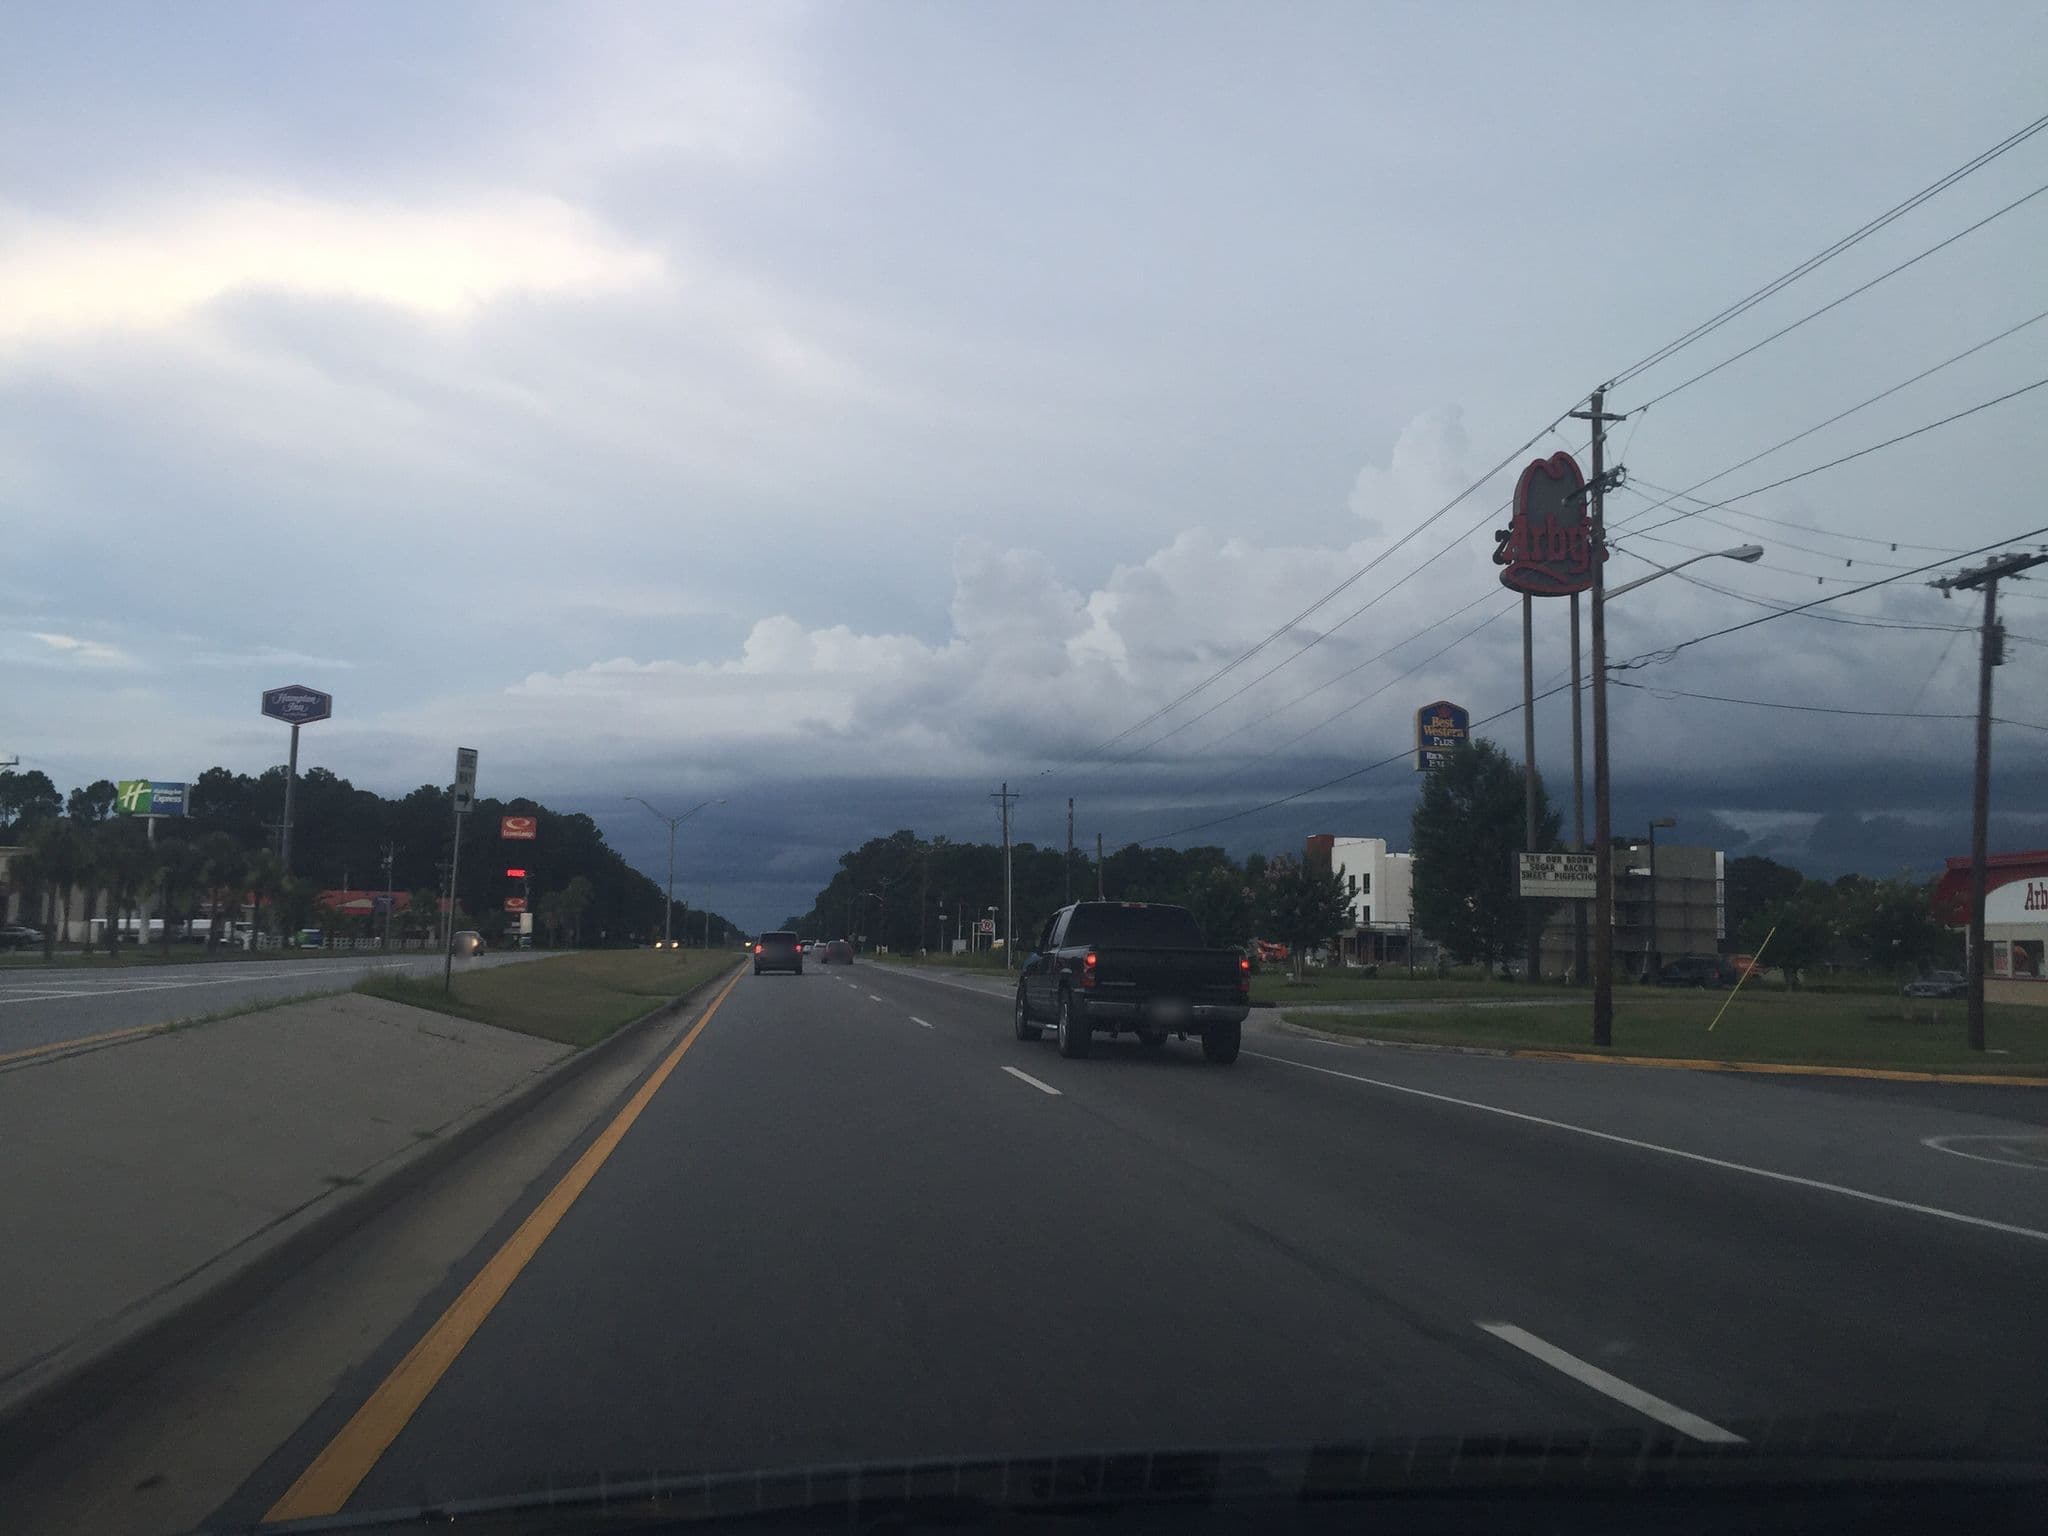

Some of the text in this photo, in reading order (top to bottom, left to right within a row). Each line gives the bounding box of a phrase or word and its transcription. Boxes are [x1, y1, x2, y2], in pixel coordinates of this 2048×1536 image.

[1432, 716, 1454, 728] Best
[1424, 725, 1465, 737] Western
[153, 794, 181, 804] Express
[1563, 864, 1588, 872] BACON
